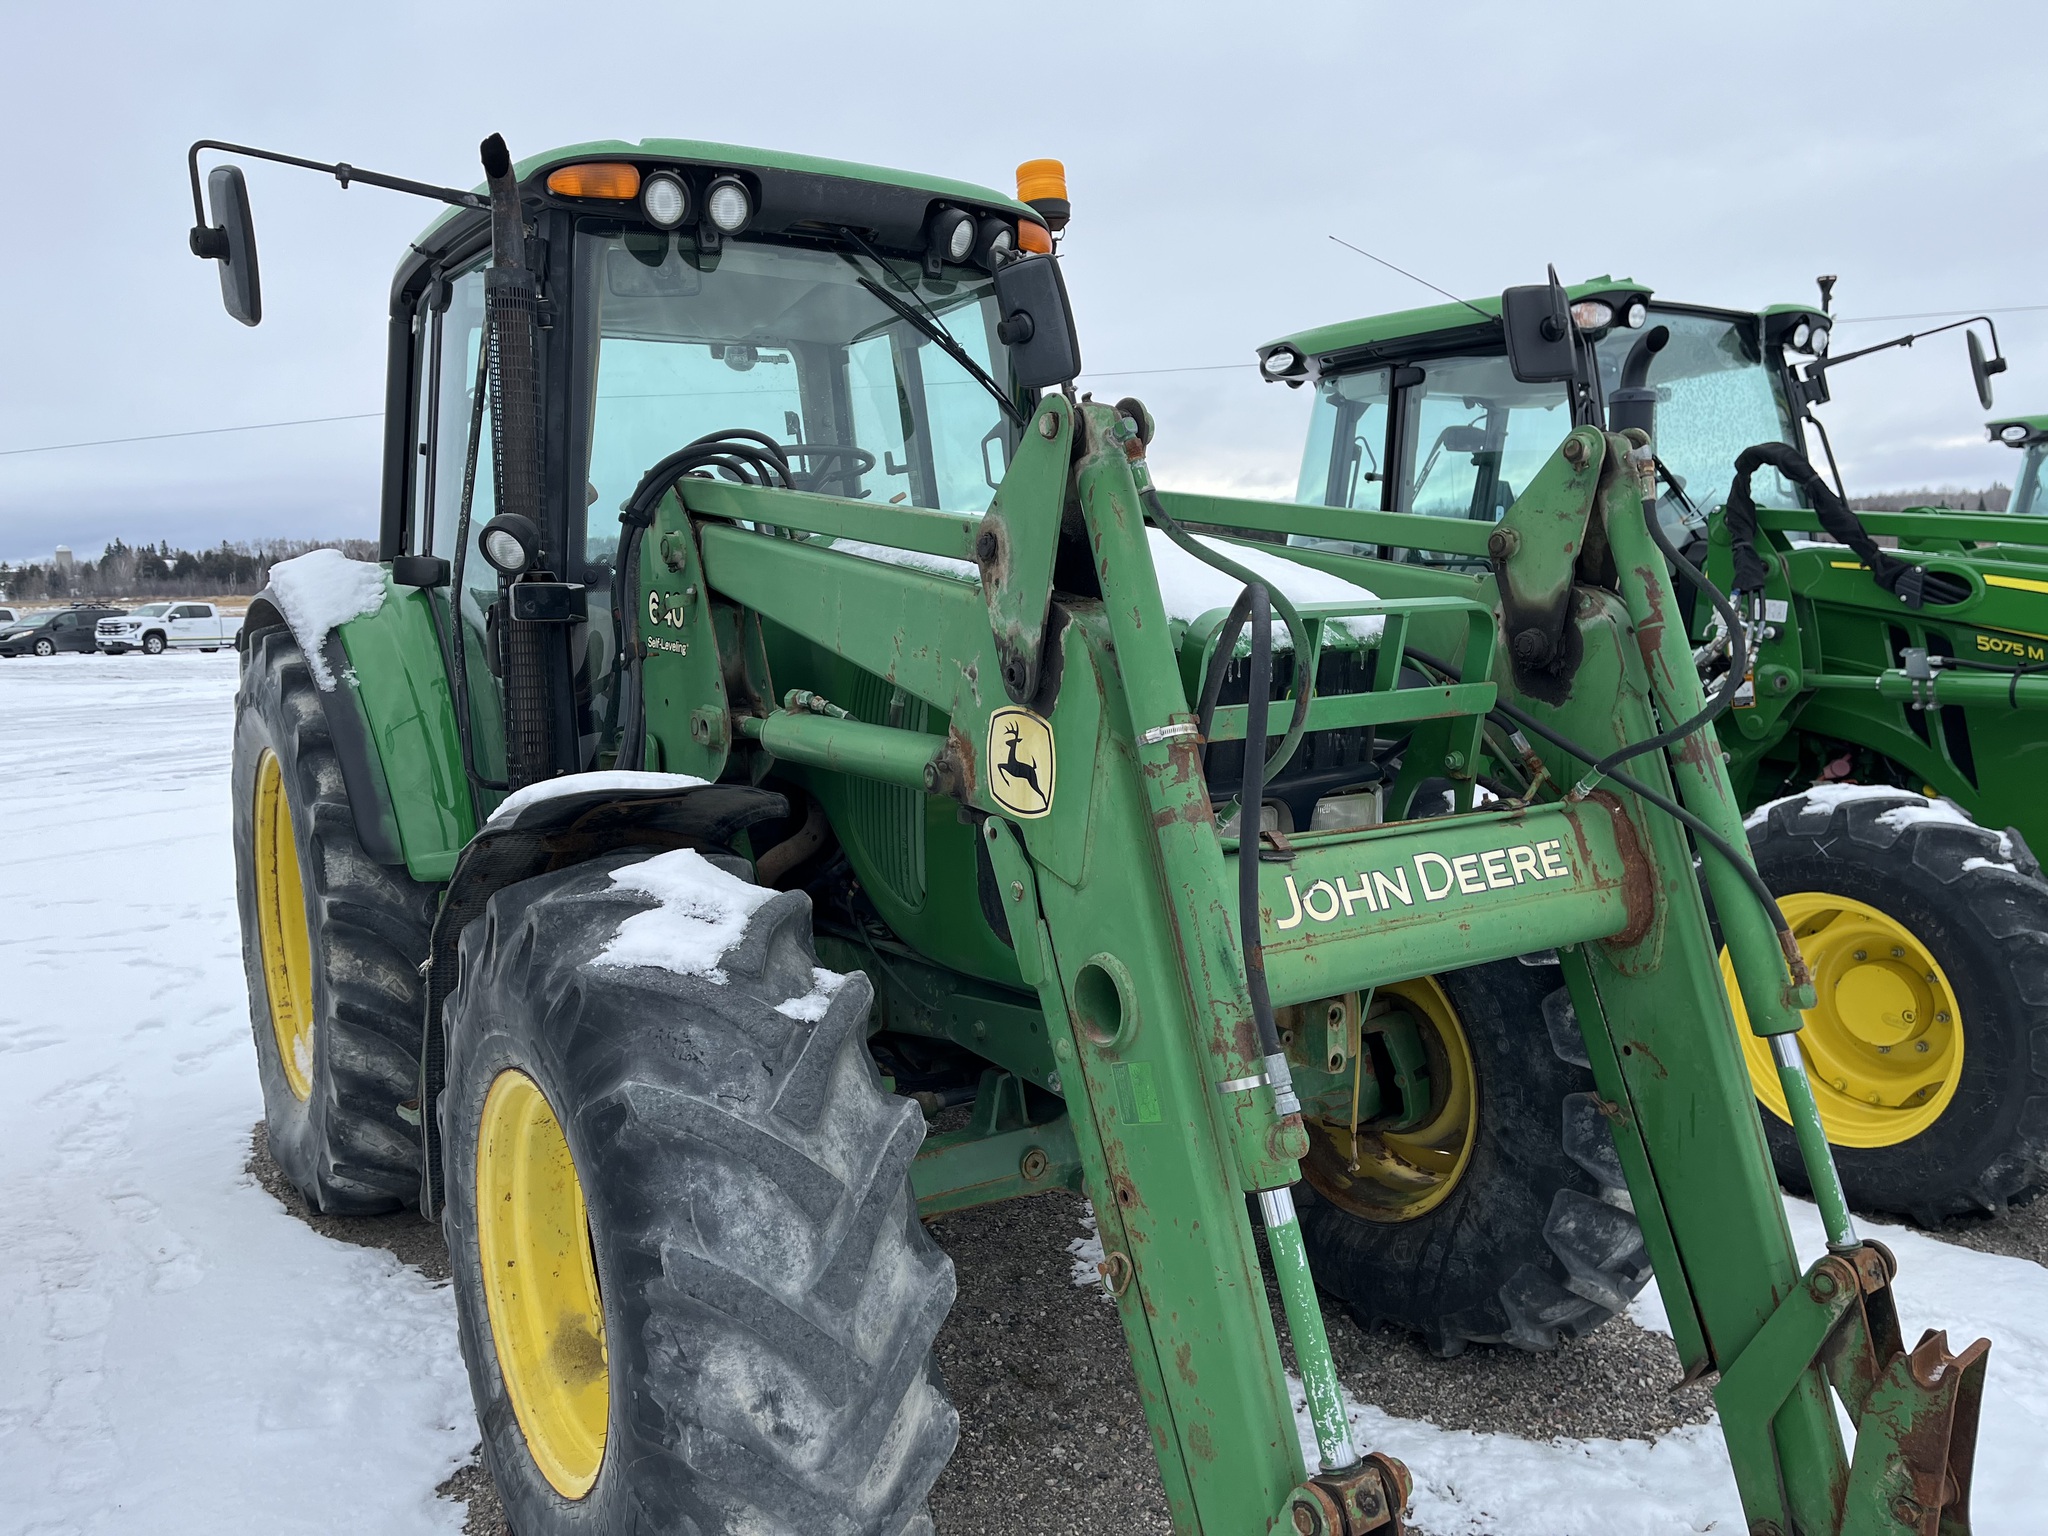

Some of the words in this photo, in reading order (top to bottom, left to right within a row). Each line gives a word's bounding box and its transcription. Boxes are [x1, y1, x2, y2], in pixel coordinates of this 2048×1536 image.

[647, 636, 687, 656] Self-Leveling
[1976, 634, 2025, 657] 5075
[2028, 645, 2045, 661] M
[1276, 866, 1413, 930] JOHN
[1412, 838, 1570, 903] DEERE
